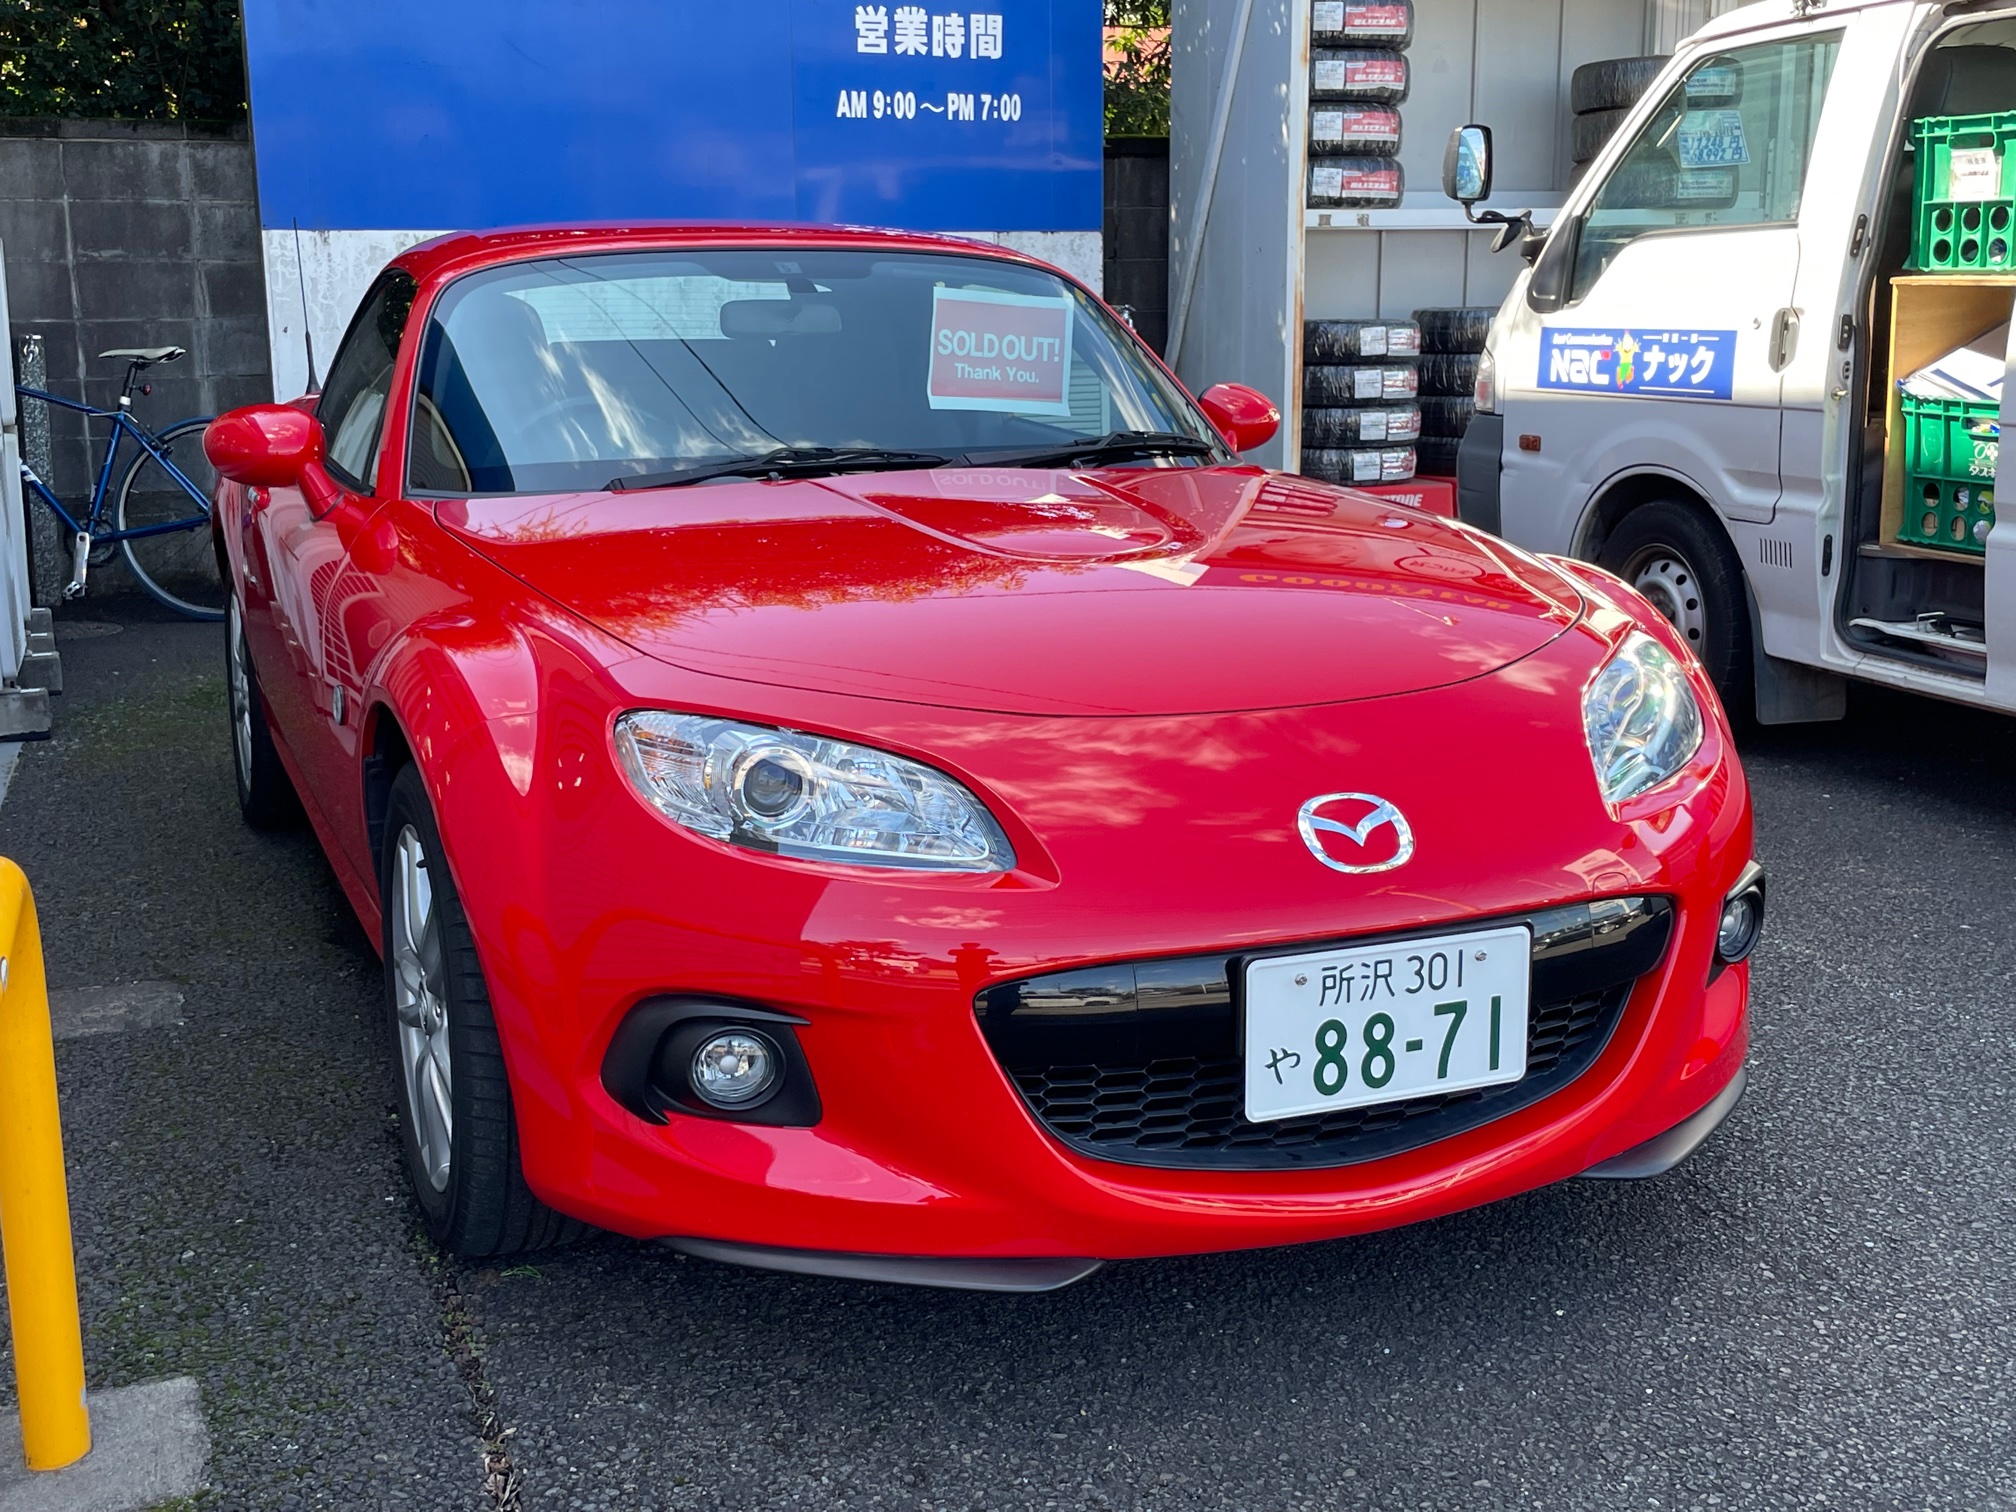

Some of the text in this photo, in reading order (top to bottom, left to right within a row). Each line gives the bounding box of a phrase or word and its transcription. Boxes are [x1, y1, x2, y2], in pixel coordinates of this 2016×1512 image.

[854, 5, 1003, 60] 営業時間
[836, 90, 867, 119] AM
[980, 93, 1022, 121] 7:00
[937, 329, 1060, 363] SOLD OUT!
[1643, 344, 1715, 385] ナック
[954, 363, 1040, 383] Thank You.
[1319, 948, 1464, 1007] 所沢 301
[1264, 995, 1502, 1097] や 88-71
